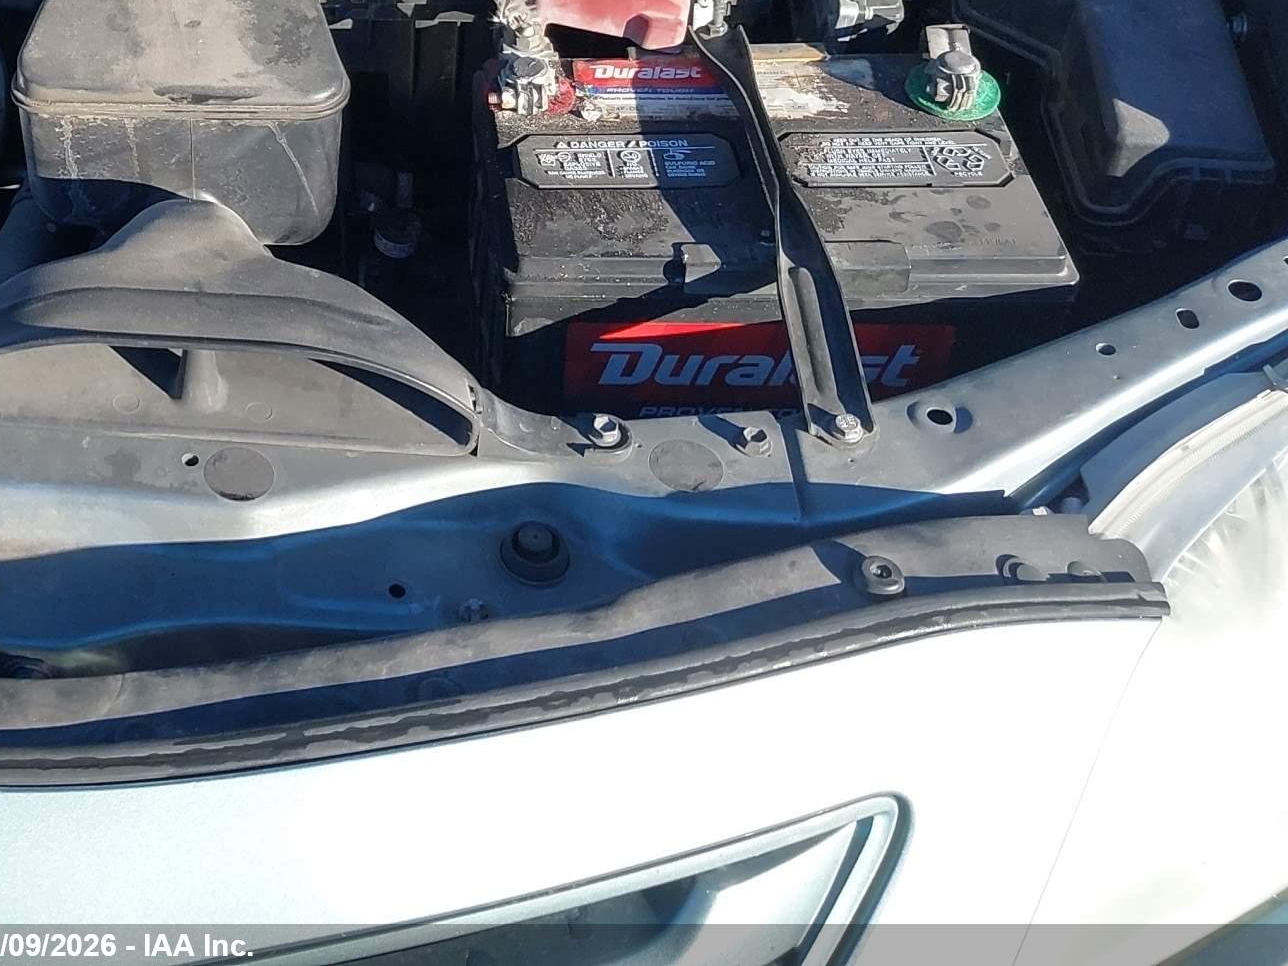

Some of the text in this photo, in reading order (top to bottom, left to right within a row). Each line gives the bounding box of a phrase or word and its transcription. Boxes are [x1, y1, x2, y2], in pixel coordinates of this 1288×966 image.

[589, 64, 703, 79] Duralast
[570, 140, 626, 148] DANGER
[639, 139, 688, 148] POISON
